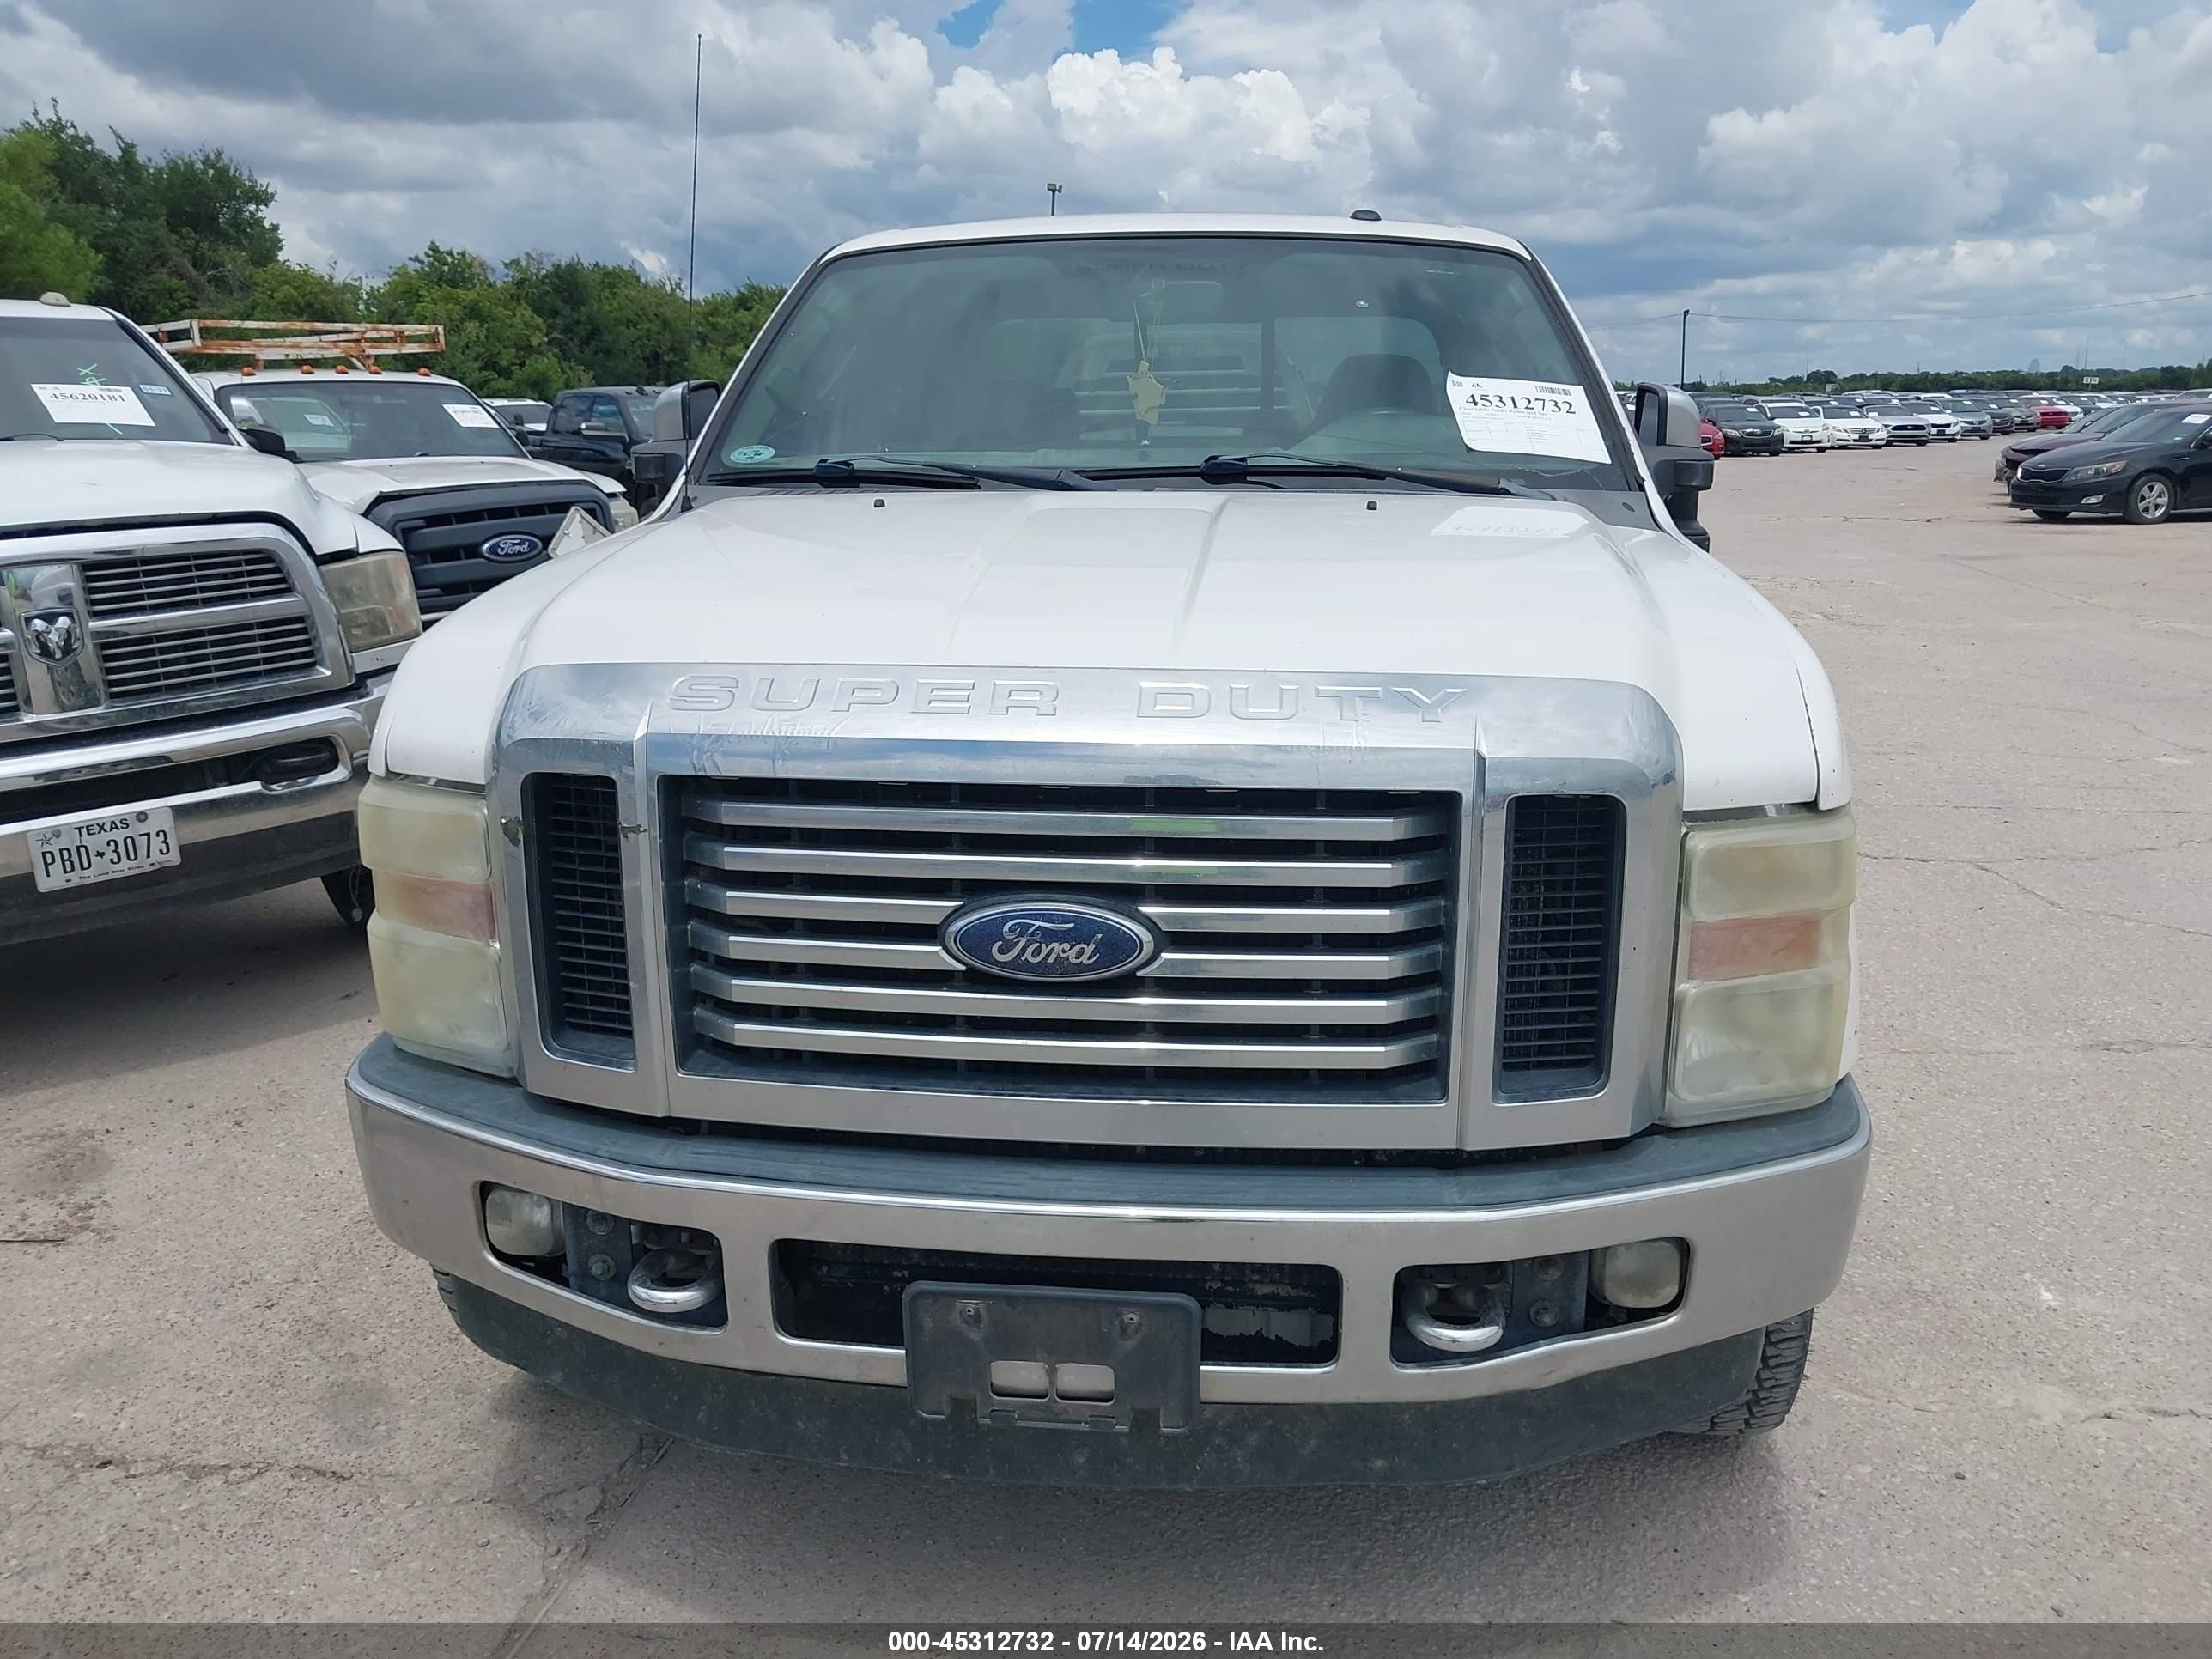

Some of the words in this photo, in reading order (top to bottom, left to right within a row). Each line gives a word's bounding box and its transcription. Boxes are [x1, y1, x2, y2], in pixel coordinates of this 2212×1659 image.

[1465, 393, 1577, 416] 45312732
[498, 539, 529, 556] Ford
[669, 675, 1059, 716] SUPER
[1136, 681, 1468, 723] DUTY
[75, 818, 130, 838] TEXAS
[992, 919, 1102, 964] Ford
